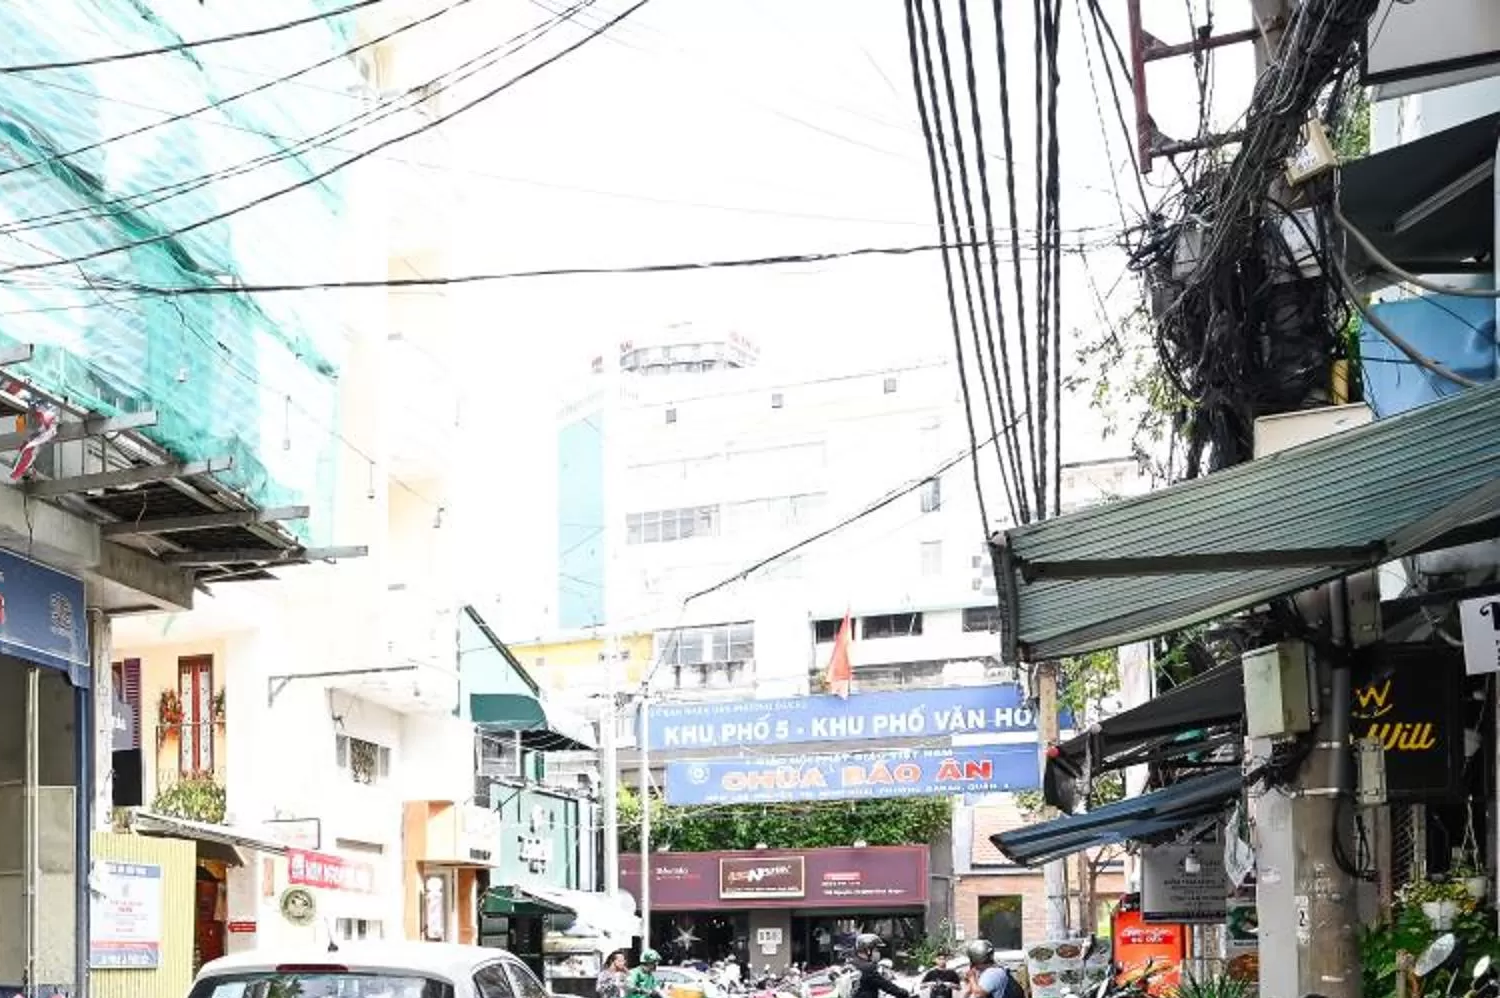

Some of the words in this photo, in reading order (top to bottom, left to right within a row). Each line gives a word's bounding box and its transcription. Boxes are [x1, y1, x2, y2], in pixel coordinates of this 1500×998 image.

[664, 723, 713, 746] KHU
[721, 713, 770, 742] PHỐ
[775, 719, 789, 739] 5
[811, 715, 864, 738] KHU
[873, 704, 925, 735] PHỐ
[934, 705, 986, 731] VĂN
[936, 757, 994, 782] ÂN
